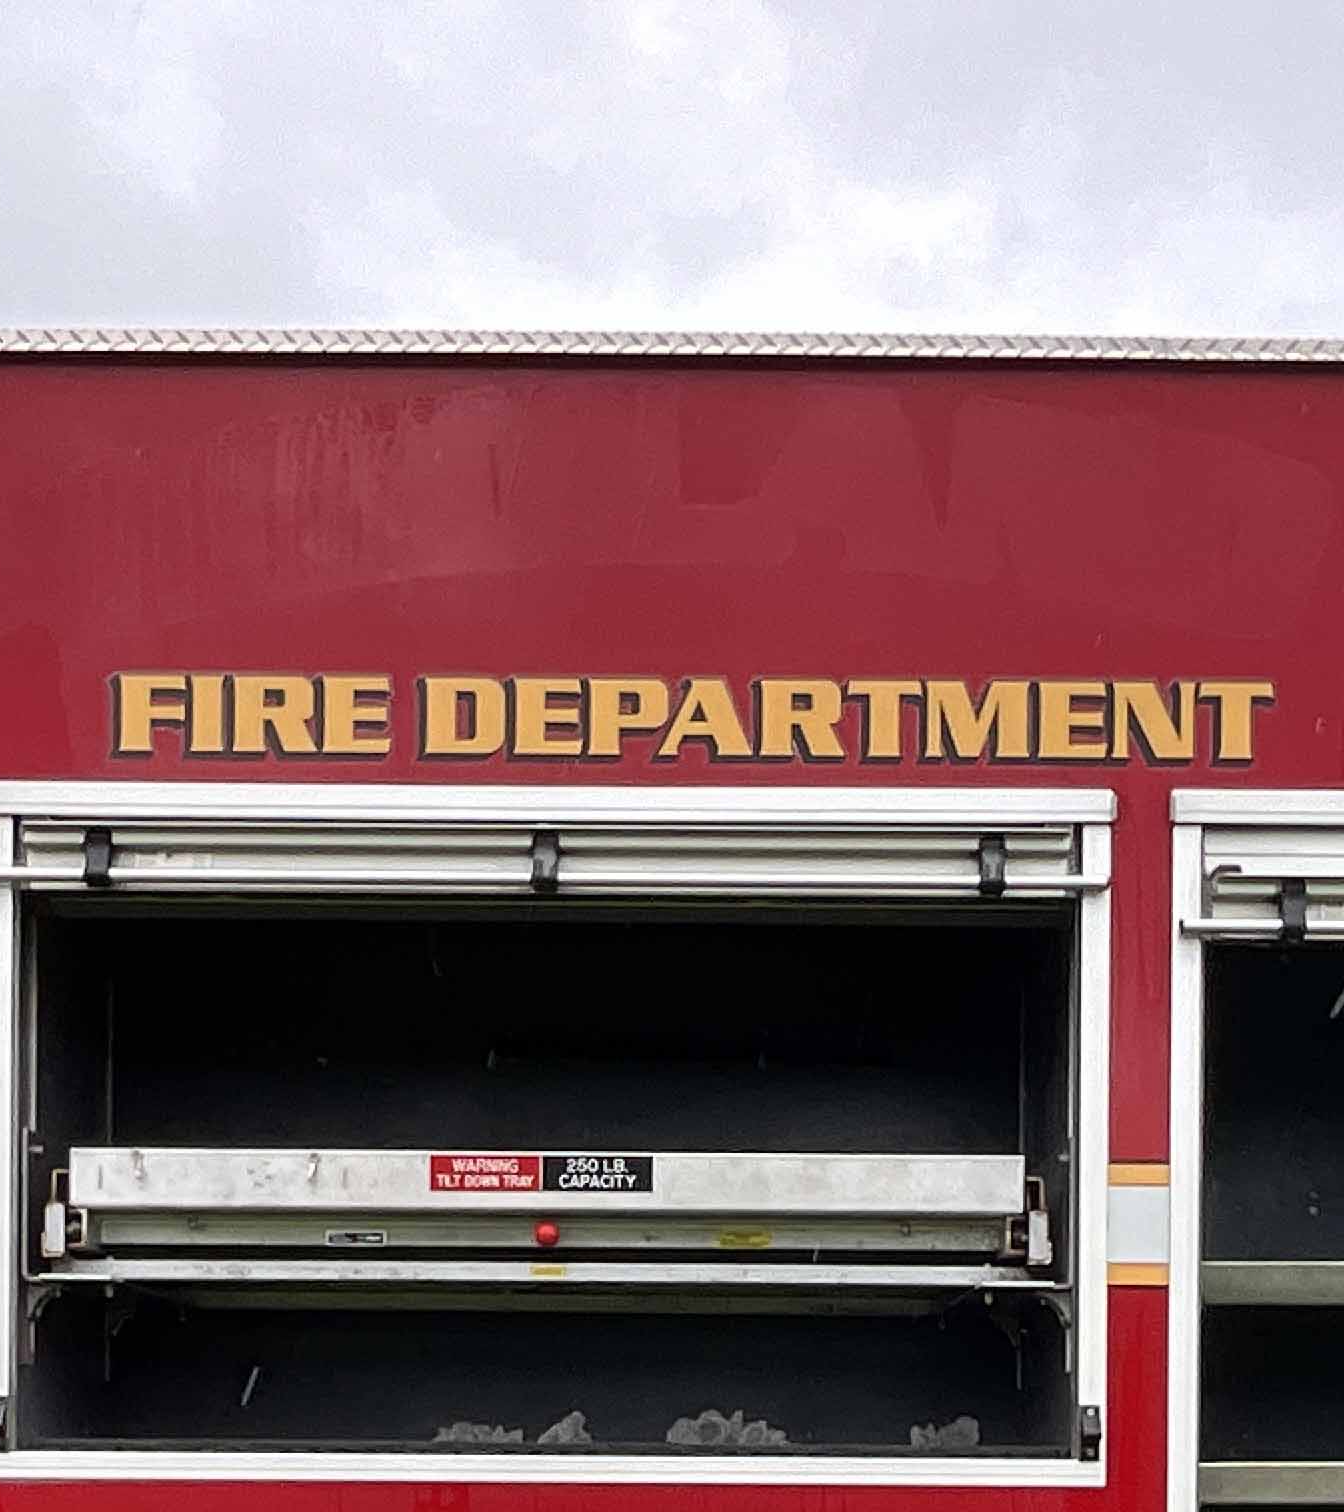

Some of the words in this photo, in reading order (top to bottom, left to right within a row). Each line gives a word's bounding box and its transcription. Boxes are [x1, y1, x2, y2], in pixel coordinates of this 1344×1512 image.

[113, 673, 392, 759] FIRE
[419, 675, 1275, 765] DEPARTMENT
[452, 1158, 519, 1173] WARNING
[566, 1158, 599, 1174] 250
[602, 1158, 628, 1174] LB.
[436, 1174, 460, 1188] TILT
[464, 1174, 500, 1188] DOWN
[502, 1174, 535, 1188] TRAY
[558, 1174, 638, 1189] CAPACITY
